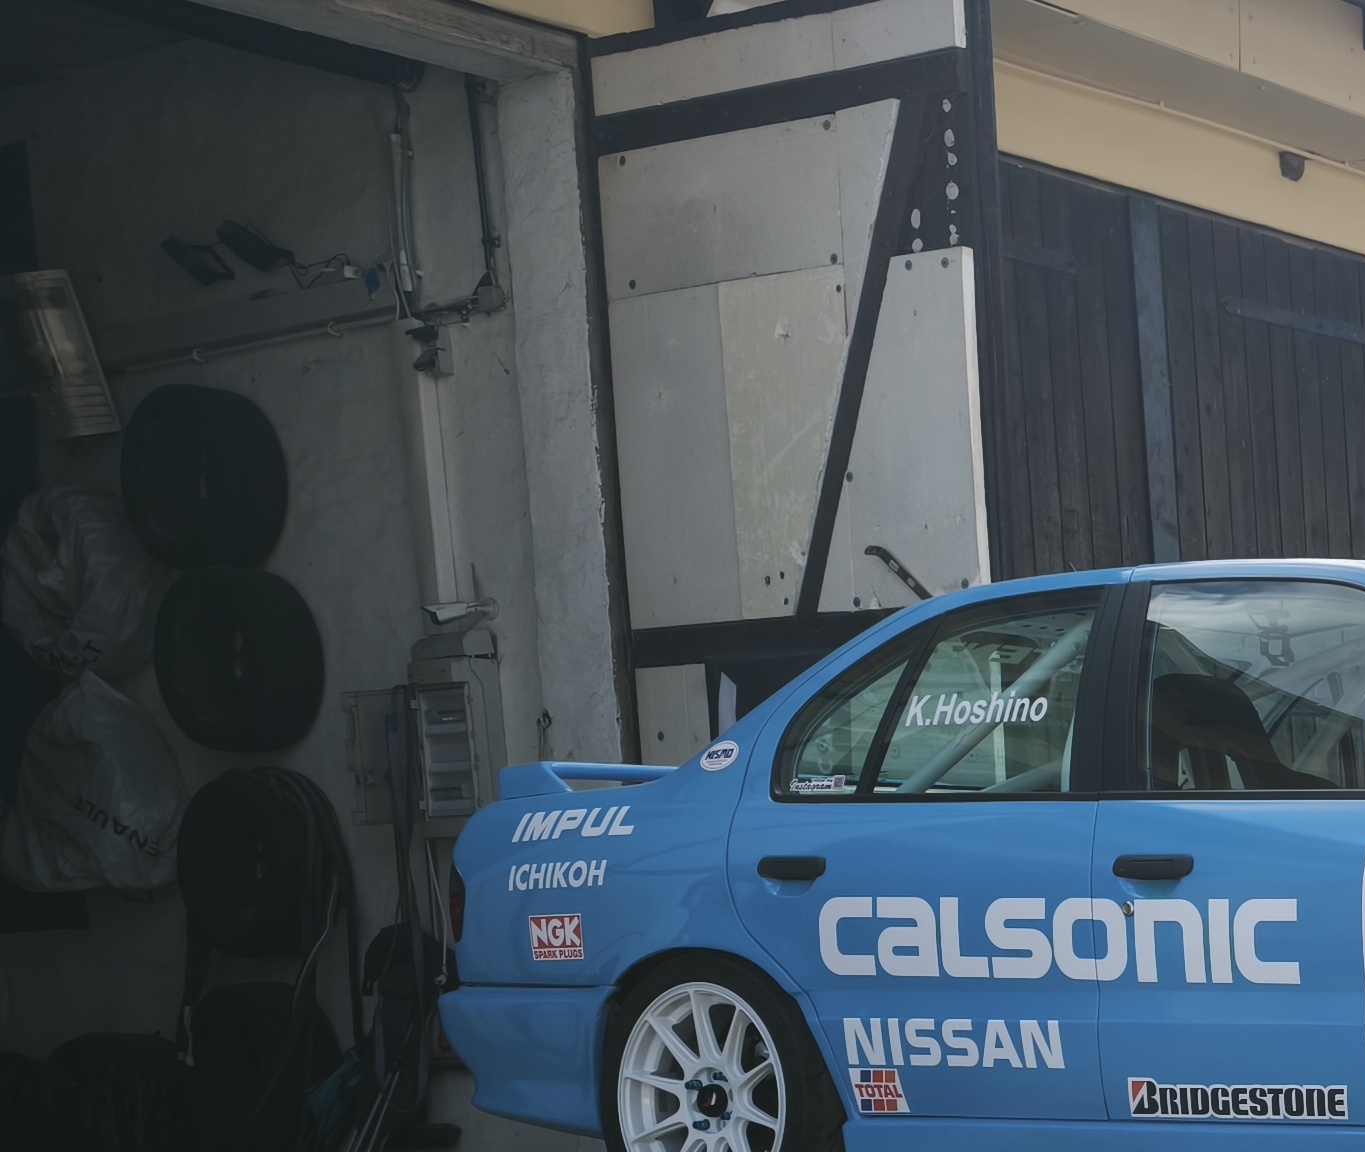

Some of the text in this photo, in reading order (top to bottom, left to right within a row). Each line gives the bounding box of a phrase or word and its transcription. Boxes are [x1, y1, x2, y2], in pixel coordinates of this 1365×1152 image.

[904, 690, 1049, 727] K.Hoshino
[704, 748, 735, 761] NISMO
[511, 805, 635, 843] IMPUL
[508, 859, 608, 891] ICHIKOH
[530, 916, 581, 948] NGK
[534, 949, 583, 960] SPARK PLUGS
[842, 1017, 1066, 1069] NISSAN
[854, 1083, 903, 1099] TOTAL
[1132, 1078, 1346, 1118] BRIDGESTONE
